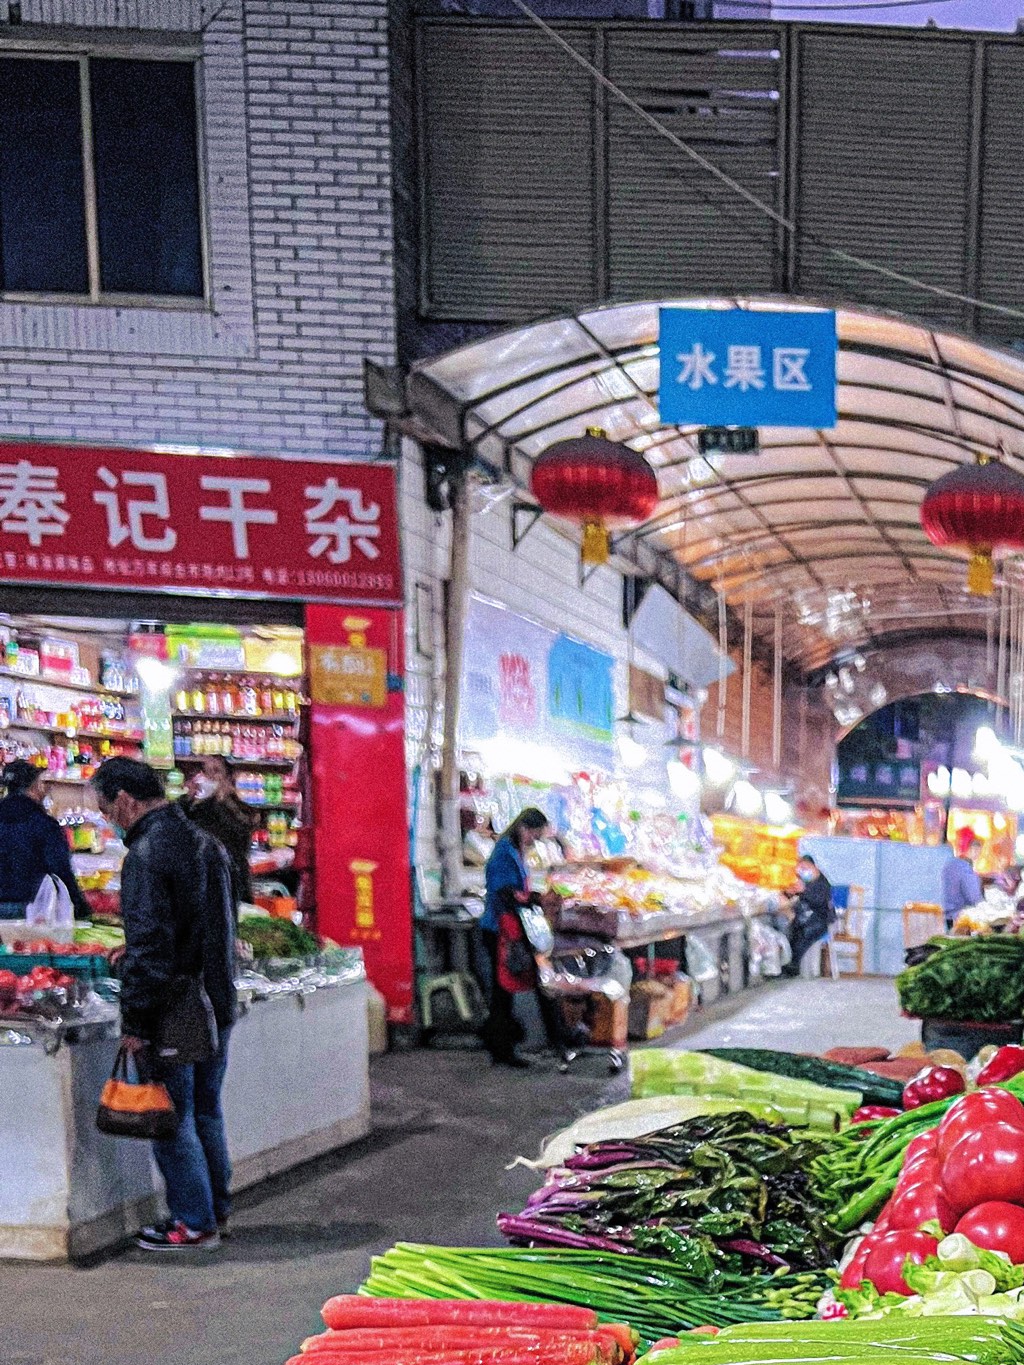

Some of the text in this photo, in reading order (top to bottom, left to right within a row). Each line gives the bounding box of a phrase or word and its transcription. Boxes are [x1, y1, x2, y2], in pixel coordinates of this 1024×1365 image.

[676, 343, 811, 392] 水果区
[0, 459, 382, 564] 奉记干杂
